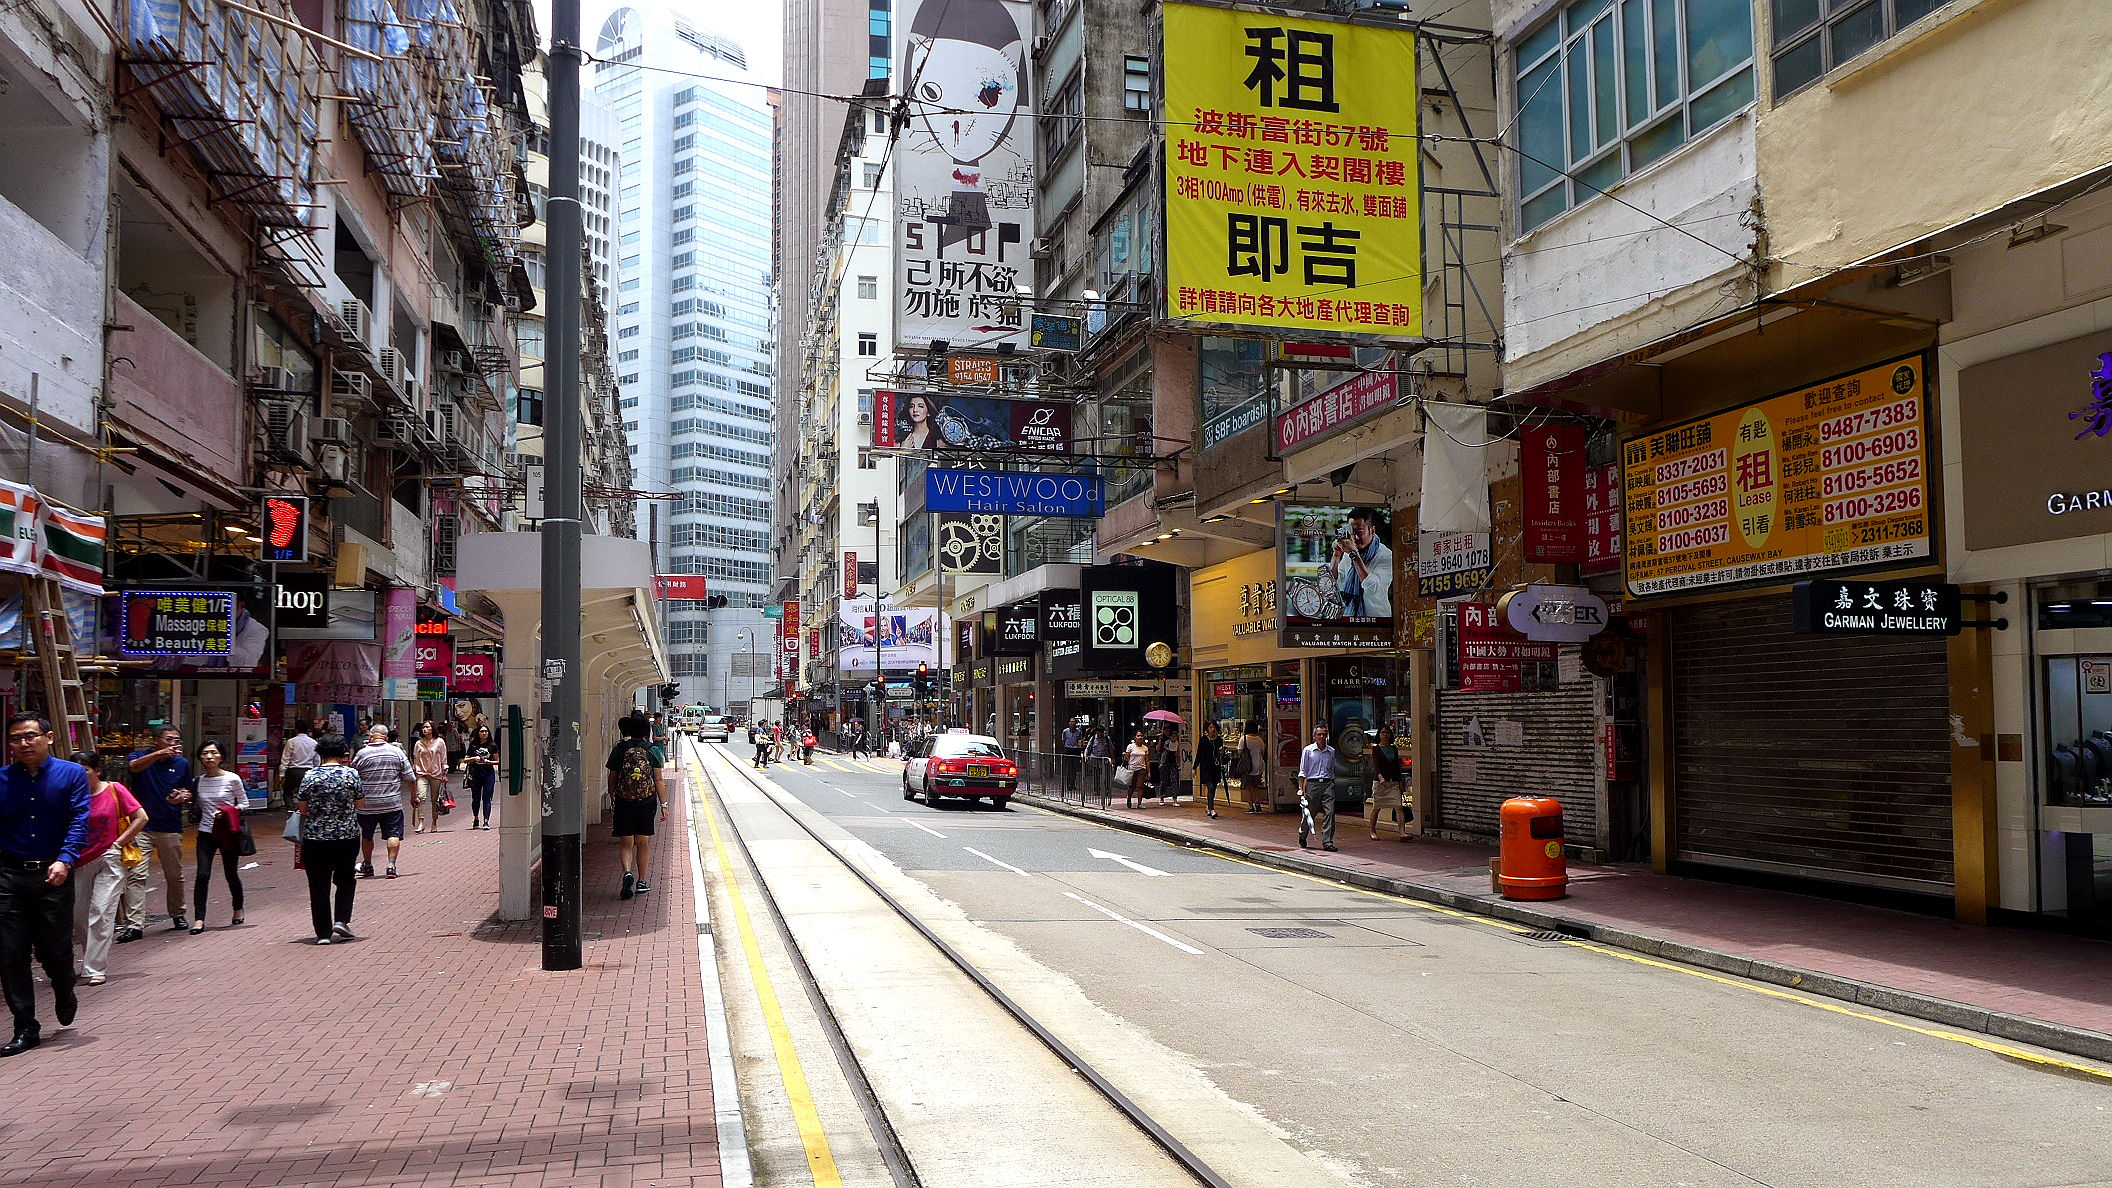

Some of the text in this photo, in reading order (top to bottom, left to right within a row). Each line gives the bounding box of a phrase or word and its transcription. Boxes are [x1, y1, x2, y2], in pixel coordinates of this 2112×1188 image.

[1243, 27, 1340, 113] 租
[1194, 107, 1389, 152] 波斯富街57號
[1177, 139, 1405, 187] 地下連入契閣樓
[1226, 213, 1361, 289] 即吉
[1179, 286, 1410, 327] 詳情請向各大地產代理查詢
[1803, 379, 1861, 410] 歡迎查詢
[1785, 392, 1885, 426] Please feel free to contact
[1821, 400, 1917, 441] 9487-7383
[1021, 427, 1062, 437] ENICAR
[1215, 418, 1231, 441] SBF
[1740, 420, 1767, 443] 有匙
[1822, 429, 1918, 468] 8100-6903
[1656, 450, 1725, 482] 8337-2031
[1736, 449, 1774, 493] 租
[1823, 458, 1920, 496] 8105-5652
[1657, 474, 1727, 506] 8105-5693
[1739, 491, 1772, 508] Lease
[967, 500, 1067, 515] Hair Salon
[1658, 501, 1729, 530] 8100-3238
[1824, 487, 1921, 522] 8100-3296
[1658, 524, 1728, 552] 8100-6037
[1742, 514, 1770, 537] 引看
[1860, 520, 1923, 544] 2311-7368
[273, 548, 293, 560] 1/F
[1441, 553, 1463, 571] 9640
[1465, 549, 1489, 568] 1078
[1665, 563, 1696, 576] PERCIVAL
[1726, 552, 1766, 565] CAUSEWAY
[1767, 548, 1783, 559] BAY
[1421, 569, 1487, 595] 2155 9693
[275, 584, 325, 616] hop
[1049, 604, 1081, 621] 六福
[1095, 595, 1124, 603] OPTICAL
[156, 615, 205, 636] Massage
[785, 603, 798, 636] 恭和堂
[1005, 618, 1035, 633] 六福
[1824, 612, 1948, 631] GARMAN JEWELLERY
[155, 637, 205, 651] Beauty
